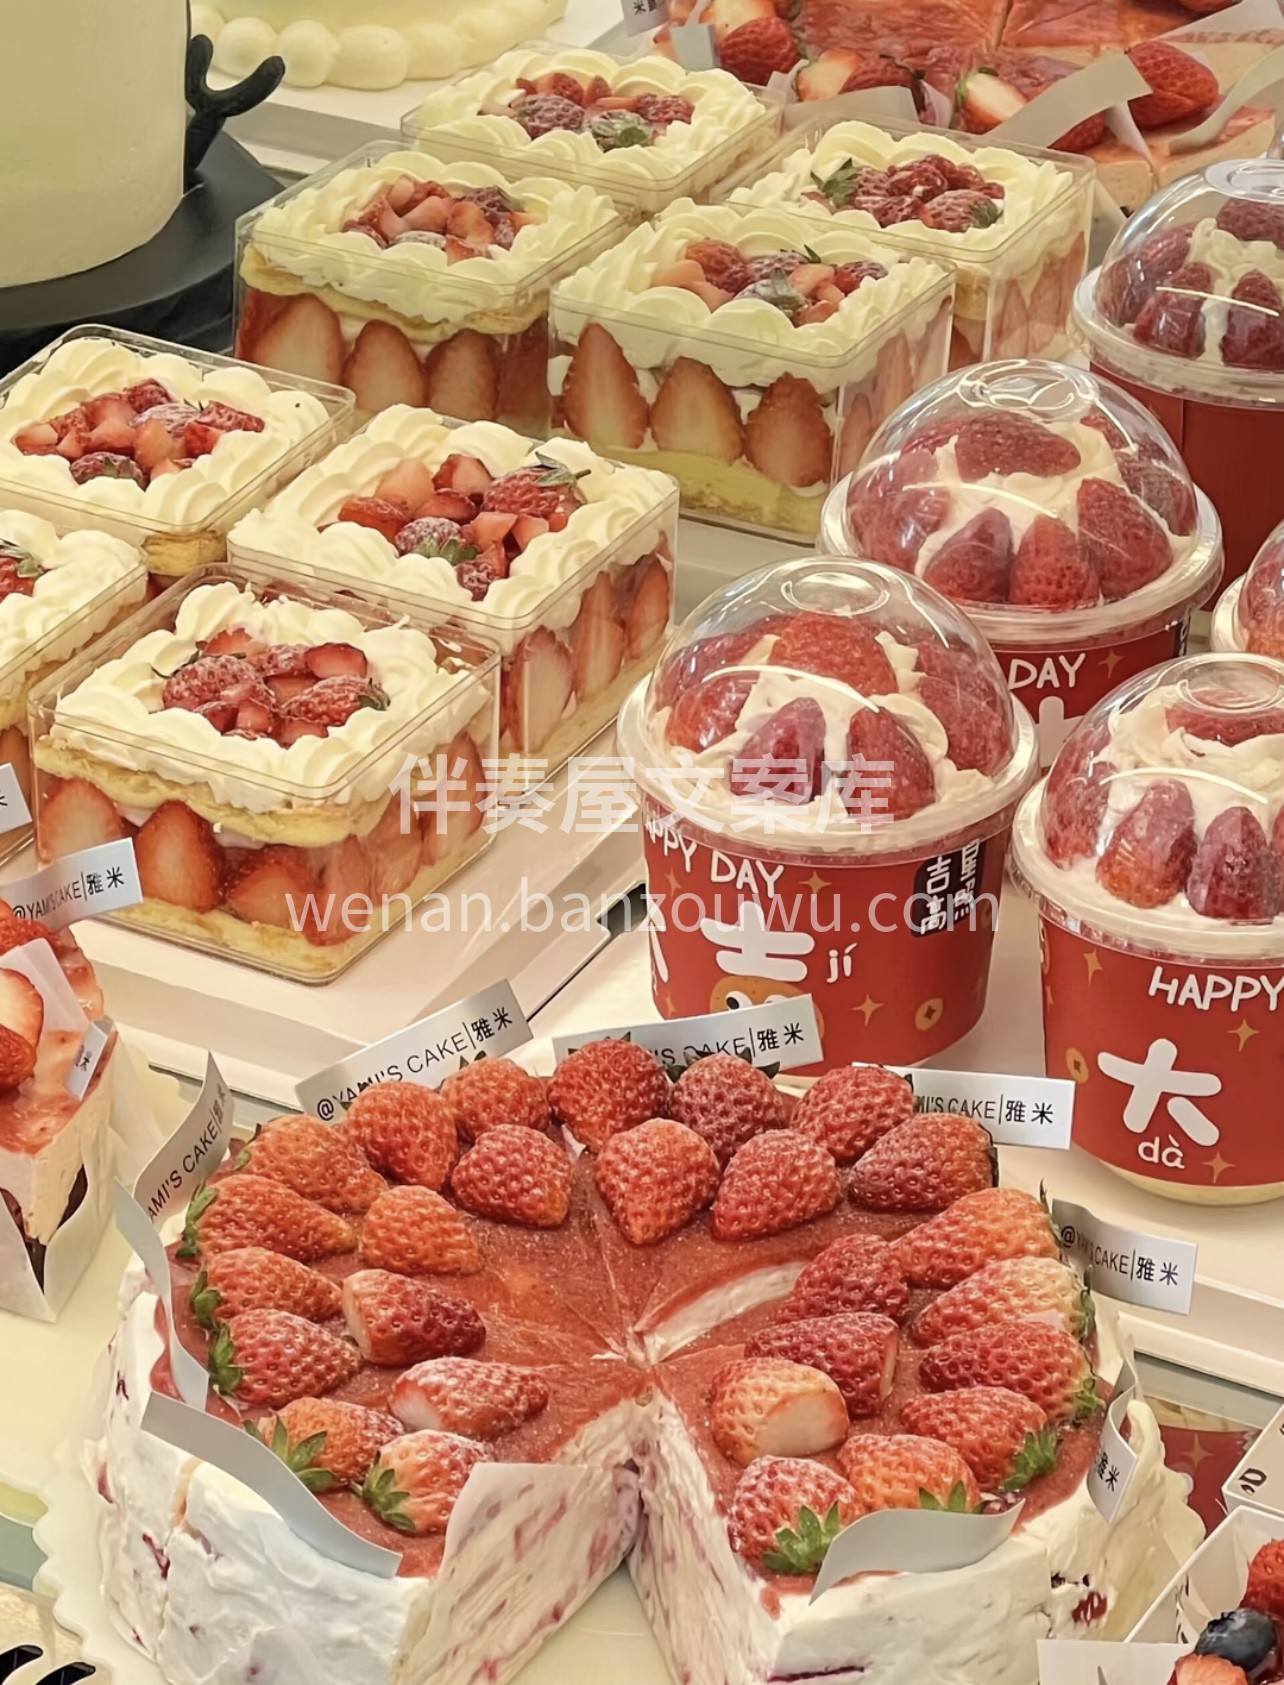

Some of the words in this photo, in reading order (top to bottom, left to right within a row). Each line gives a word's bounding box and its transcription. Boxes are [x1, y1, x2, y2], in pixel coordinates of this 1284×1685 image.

[1008, 652, 1086, 690] DAY
[711, 850, 784, 899] DAY
[826, 943, 858, 984] jí
[1148, 966, 1284, 1012] HAPPY
[471, 1006, 513, 1042] 雅米
[756, 1022, 805, 1052] 雅米
[407, 1033, 468, 1074] CAKE
[948, 1097, 996, 1119] CAKE
[1097, 1038, 1222, 1147] 大
[1005, 1099, 1053, 1125] 雅米
[182, 1120, 218, 1174] CAKE
[1138, 1134, 1185, 1169] dà
[1095, 1246, 1130, 1275] CAKE
[1136, 1256, 1179, 1286] 雅米
